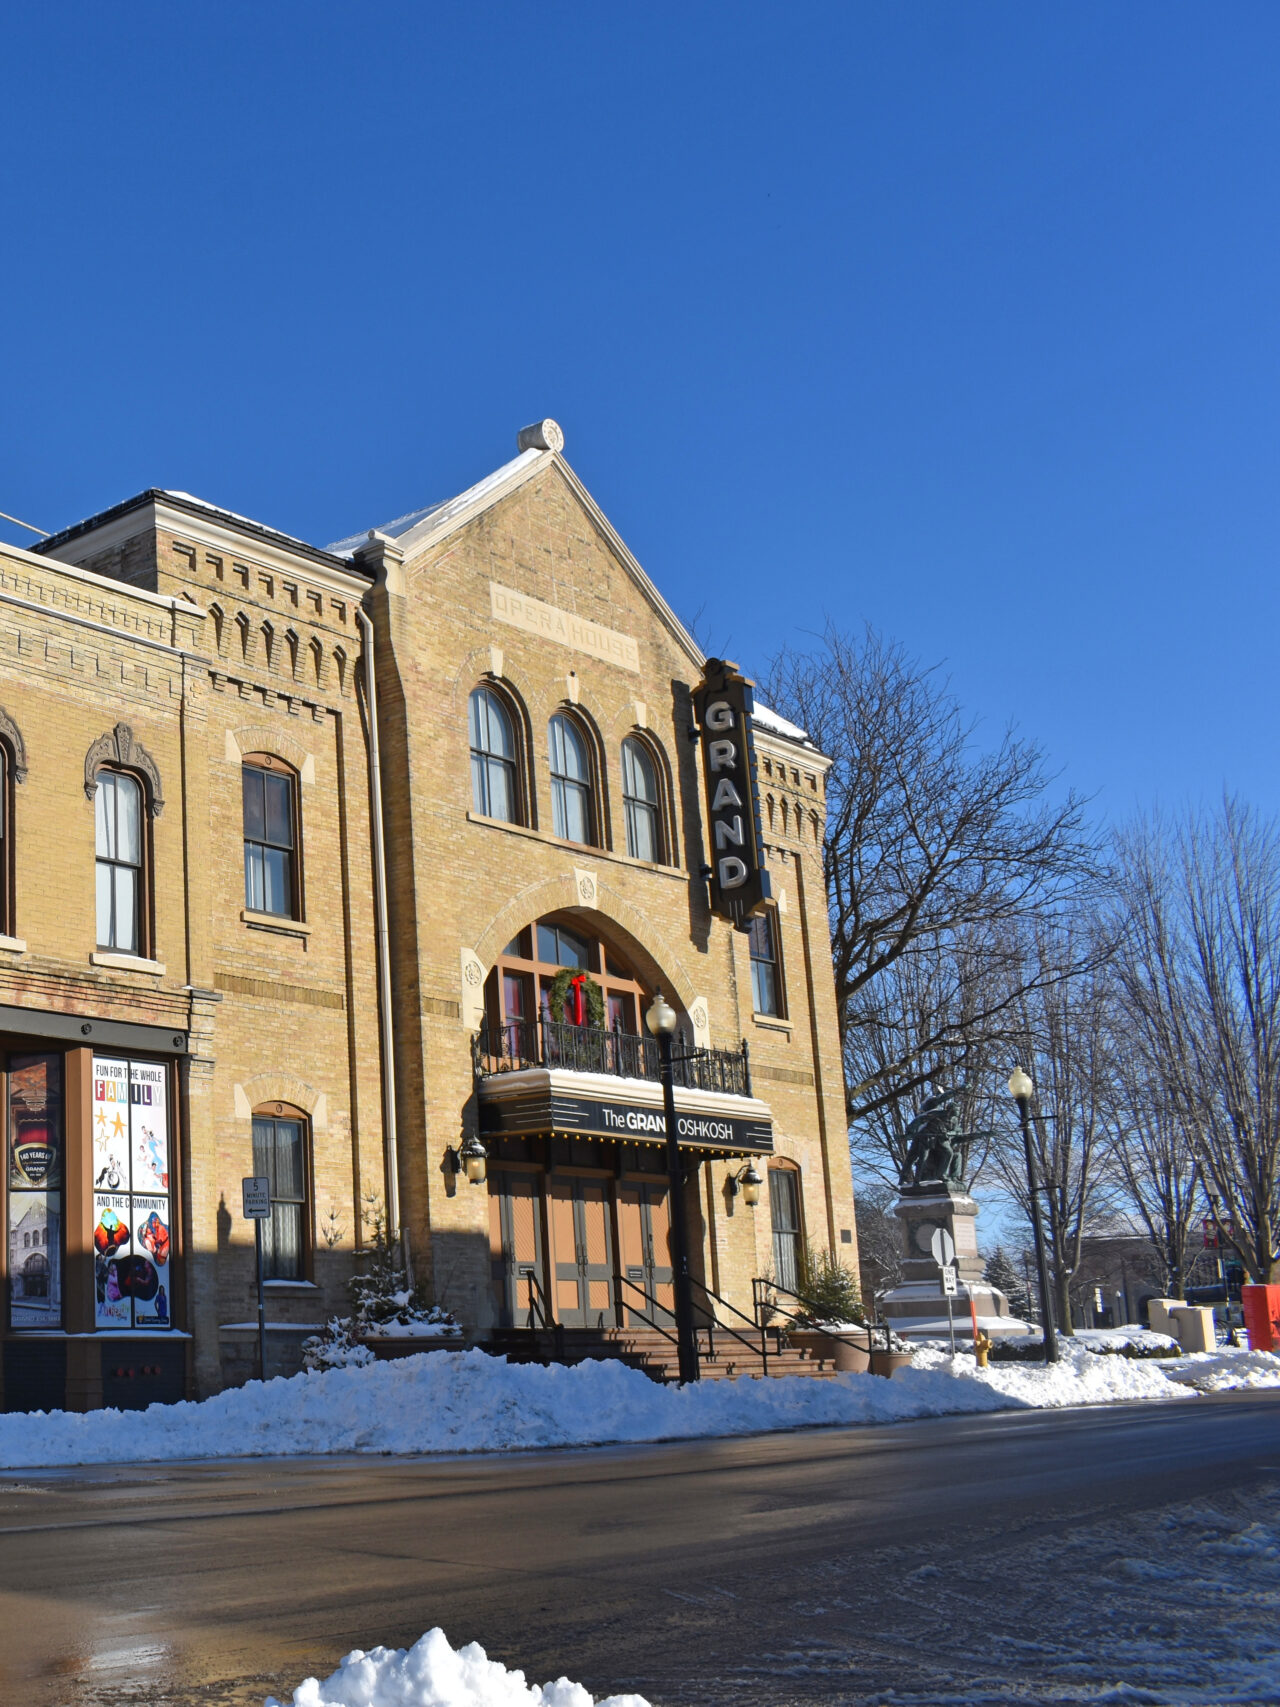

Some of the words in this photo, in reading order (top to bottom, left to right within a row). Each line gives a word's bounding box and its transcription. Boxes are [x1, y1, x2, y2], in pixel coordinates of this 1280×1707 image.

[495, 592, 566, 637] OPERA
[571, 621, 638, 664] HOUSE
[705, 700, 748, 889] GRAND
[96, 1065, 109, 1077] FUN
[110, 1066, 123, 1078] FOR
[140, 1070, 162, 1082] WHOLE
[95, 1079, 162, 1105] FAMILY
[602, 1109, 625, 1128] The
[627, 1112, 667, 1133] GRAN
[677, 1118, 734, 1140] OSHKOSH
[254, 1181, 259, 1191] 5
[97, 1196, 110, 1207] AND
[111, 1197, 124, 1208] THE
[125, 1198, 166, 1210] COMMUNITY
